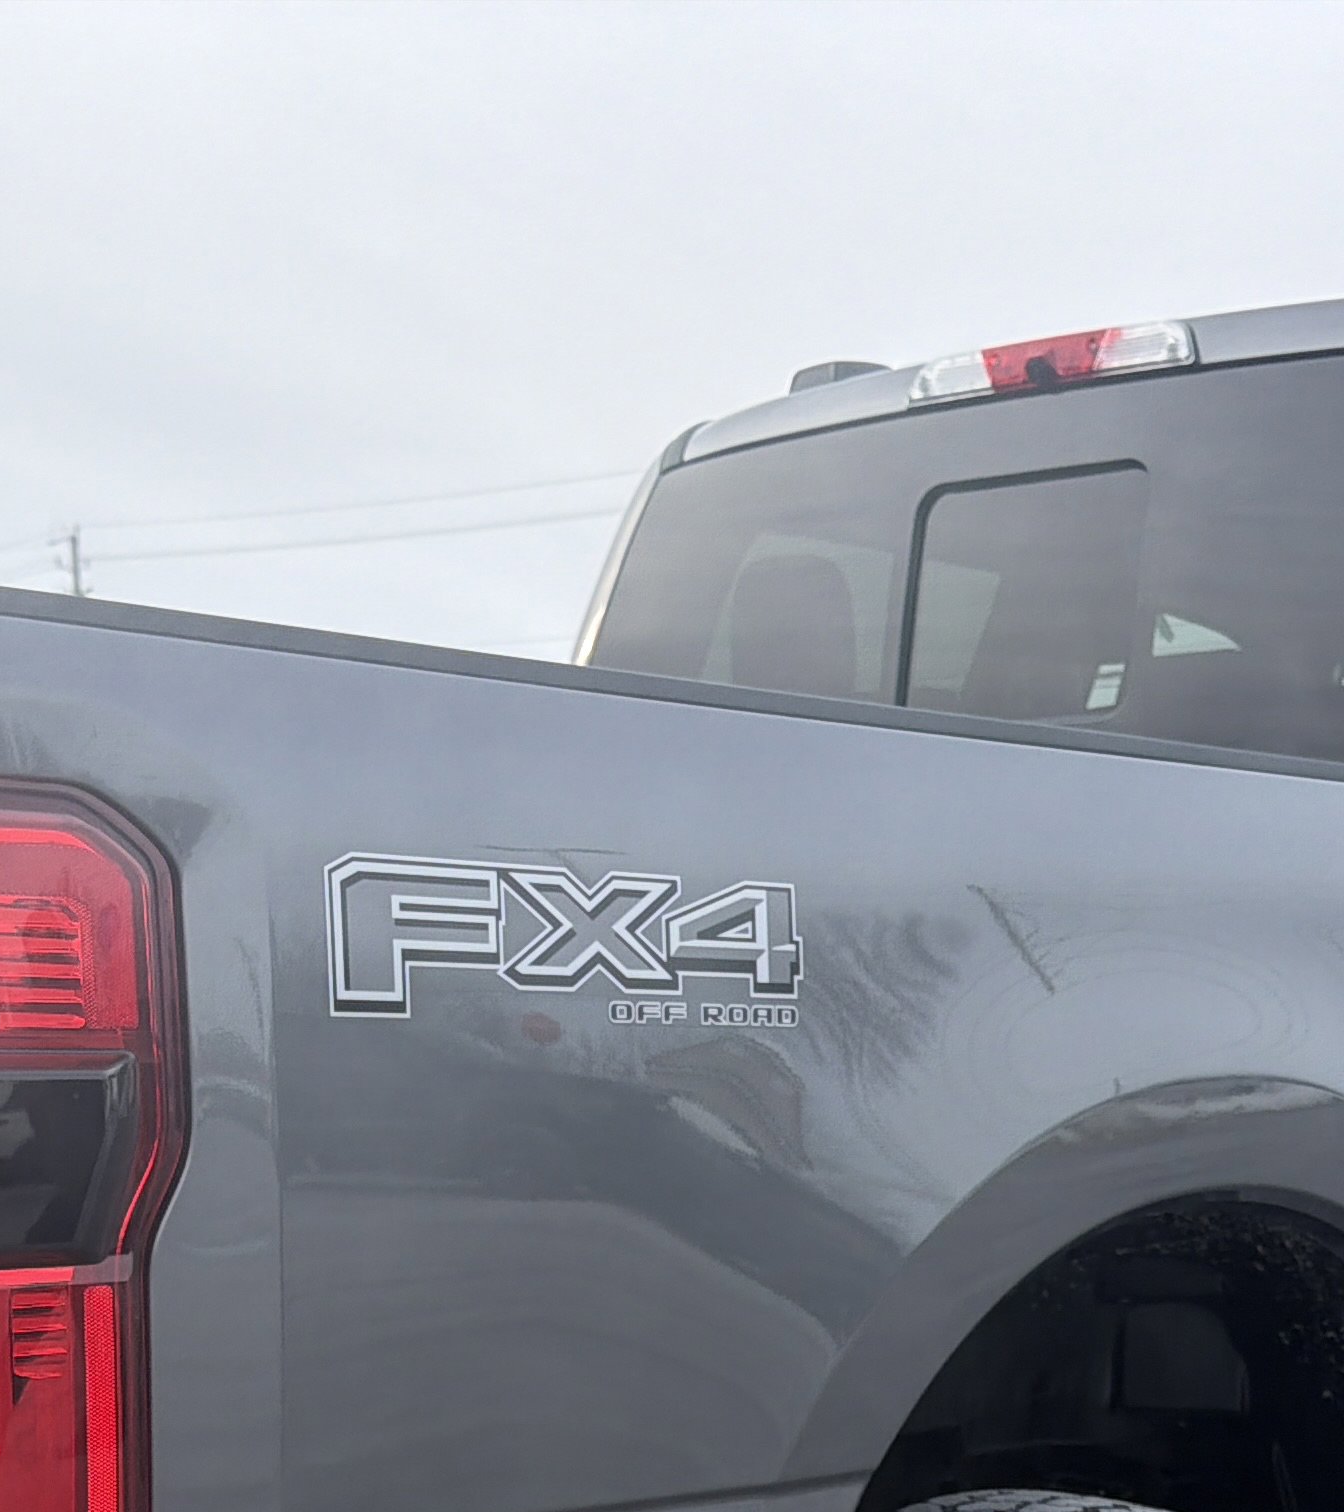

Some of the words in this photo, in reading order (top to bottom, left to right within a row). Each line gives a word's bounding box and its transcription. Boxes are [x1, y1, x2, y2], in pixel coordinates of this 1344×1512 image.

[323, 850, 804, 1018] FX4
[608, 1000, 690, 1025] OFF
[700, 1002, 800, 1027] ROAD
